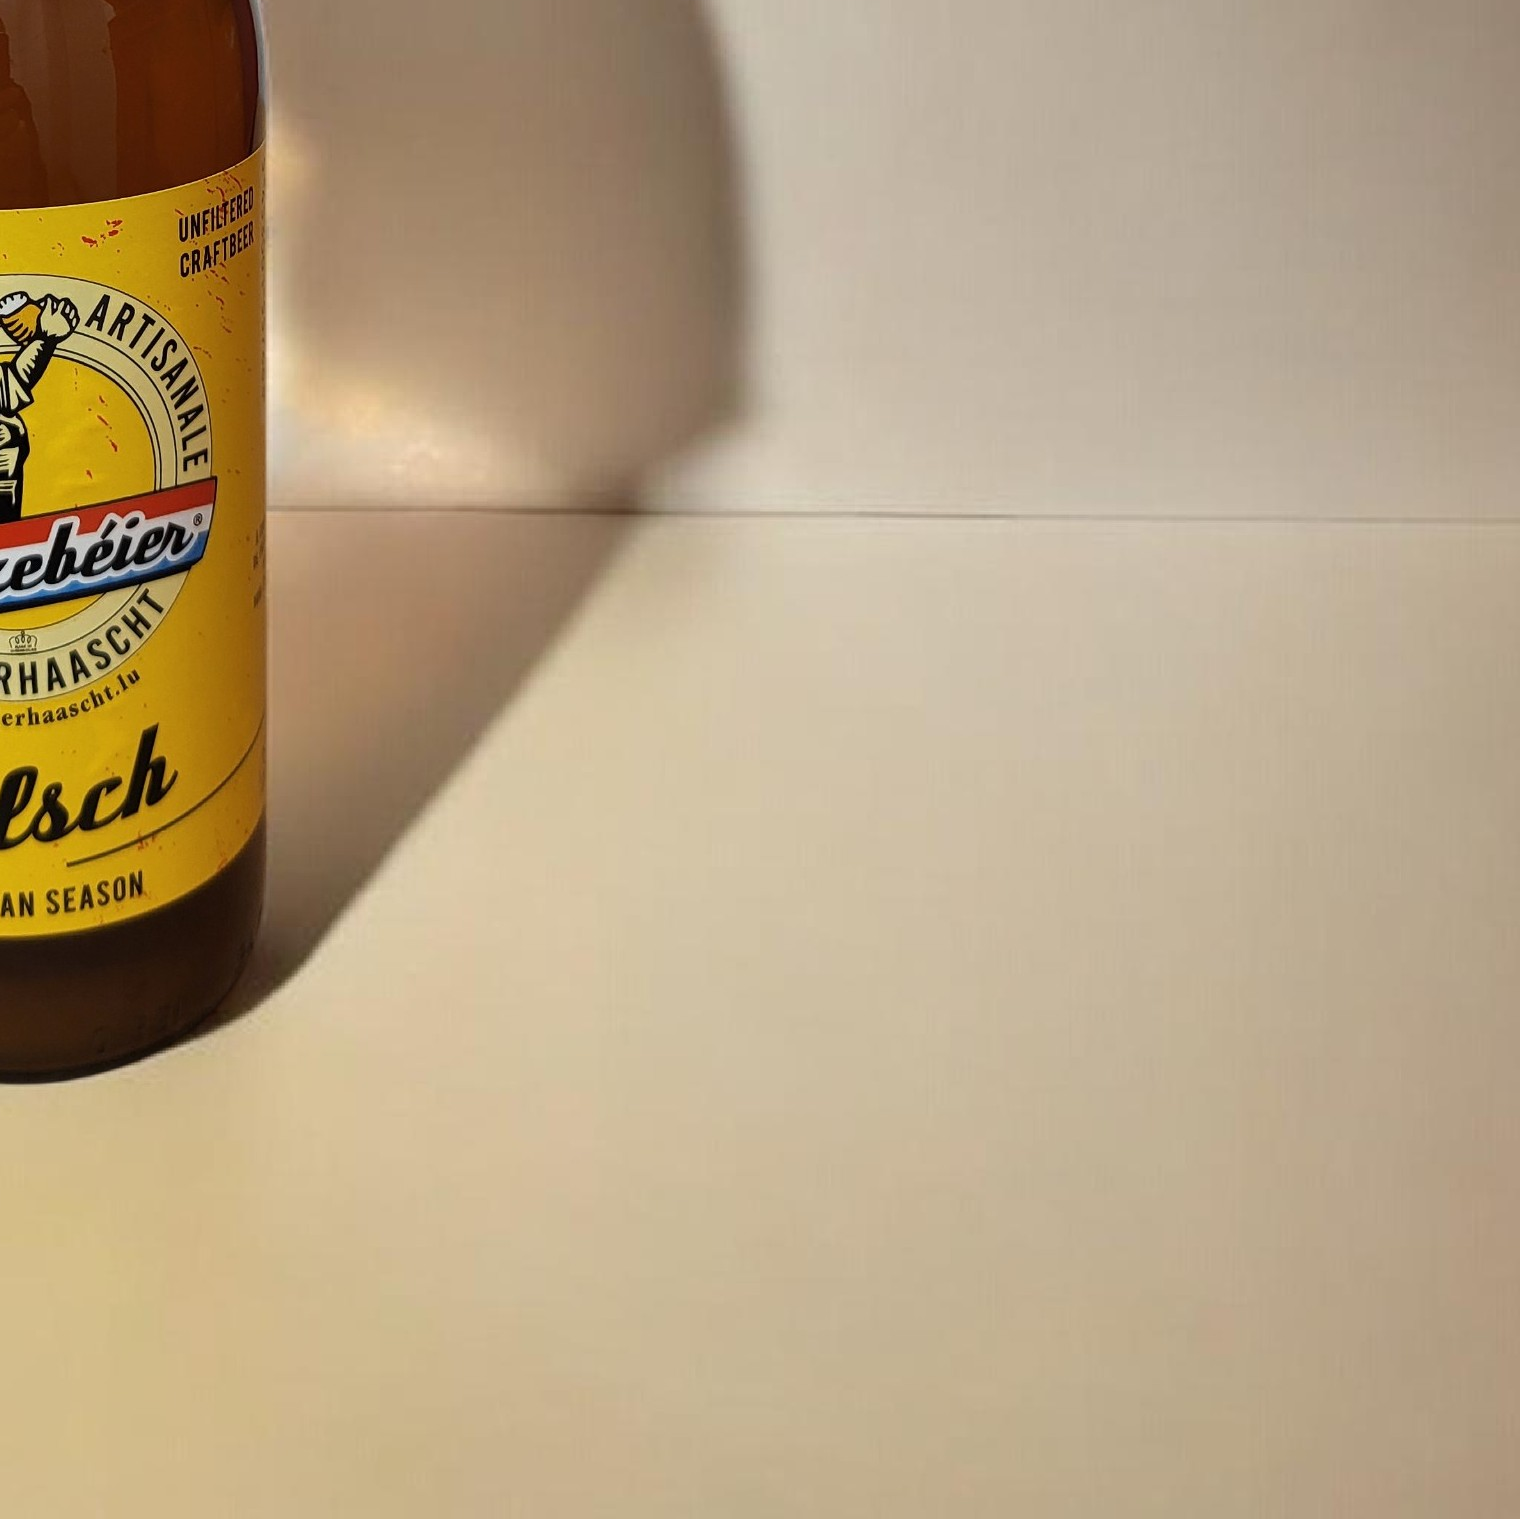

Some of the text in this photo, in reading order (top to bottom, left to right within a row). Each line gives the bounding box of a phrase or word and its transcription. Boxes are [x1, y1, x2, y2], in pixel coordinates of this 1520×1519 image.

[179, 186, 254, 243] UNFILTERED
[180, 220, 255, 278] CRAFTBEER
[84, 293, 208, 472] ARTISANALE
[45, 869, 144, 916] SEASON
